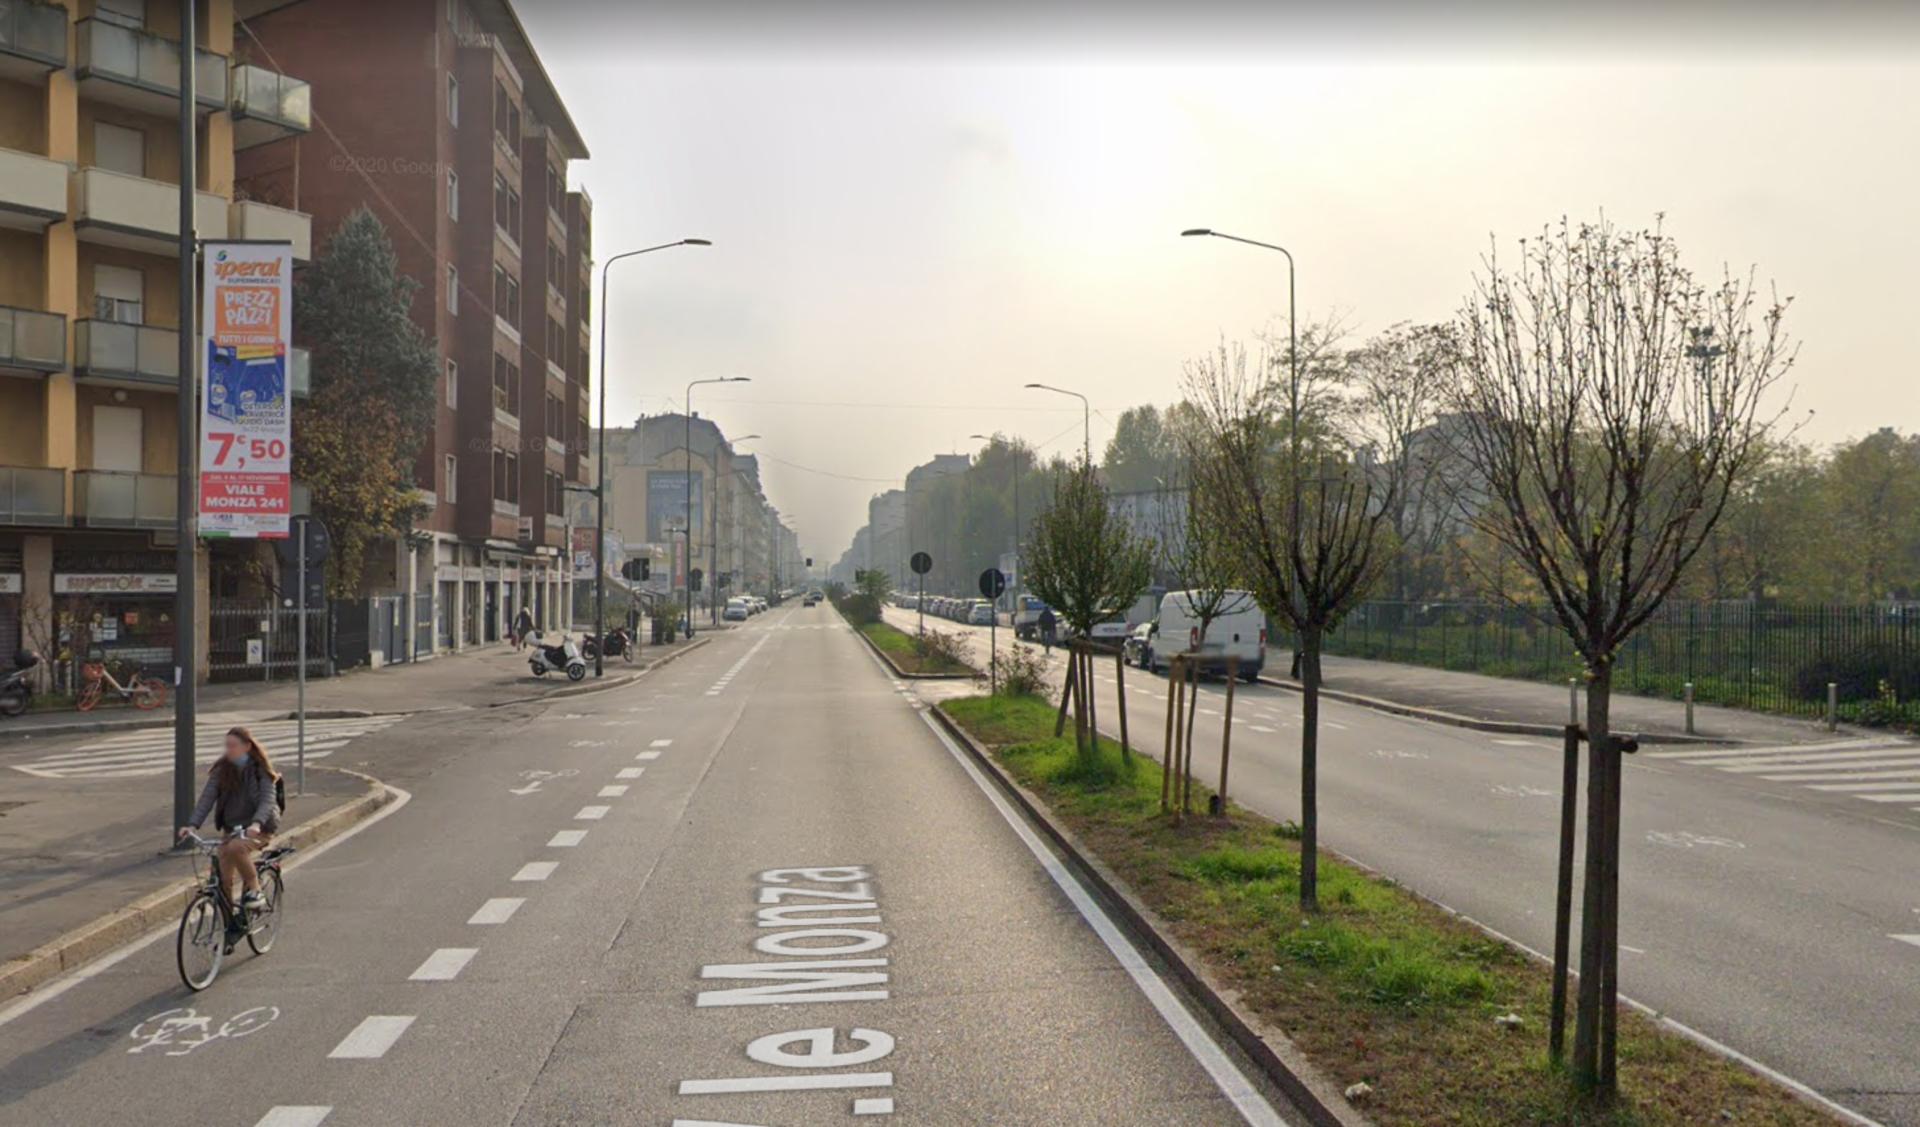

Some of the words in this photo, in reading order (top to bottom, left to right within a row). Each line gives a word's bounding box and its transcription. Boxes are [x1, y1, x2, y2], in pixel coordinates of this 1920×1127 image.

[214, 256, 282, 279] iperal
[224, 290, 275, 308] PREZZI
[225, 306, 272, 326] PAZZI
[225, 484, 265, 496] VIALE
[205, 496, 257, 508] MONZA
[259, 498, 284, 509] 241
[696, 864, 890, 1007] Monza
[672, 1027, 895, 1127] .le
